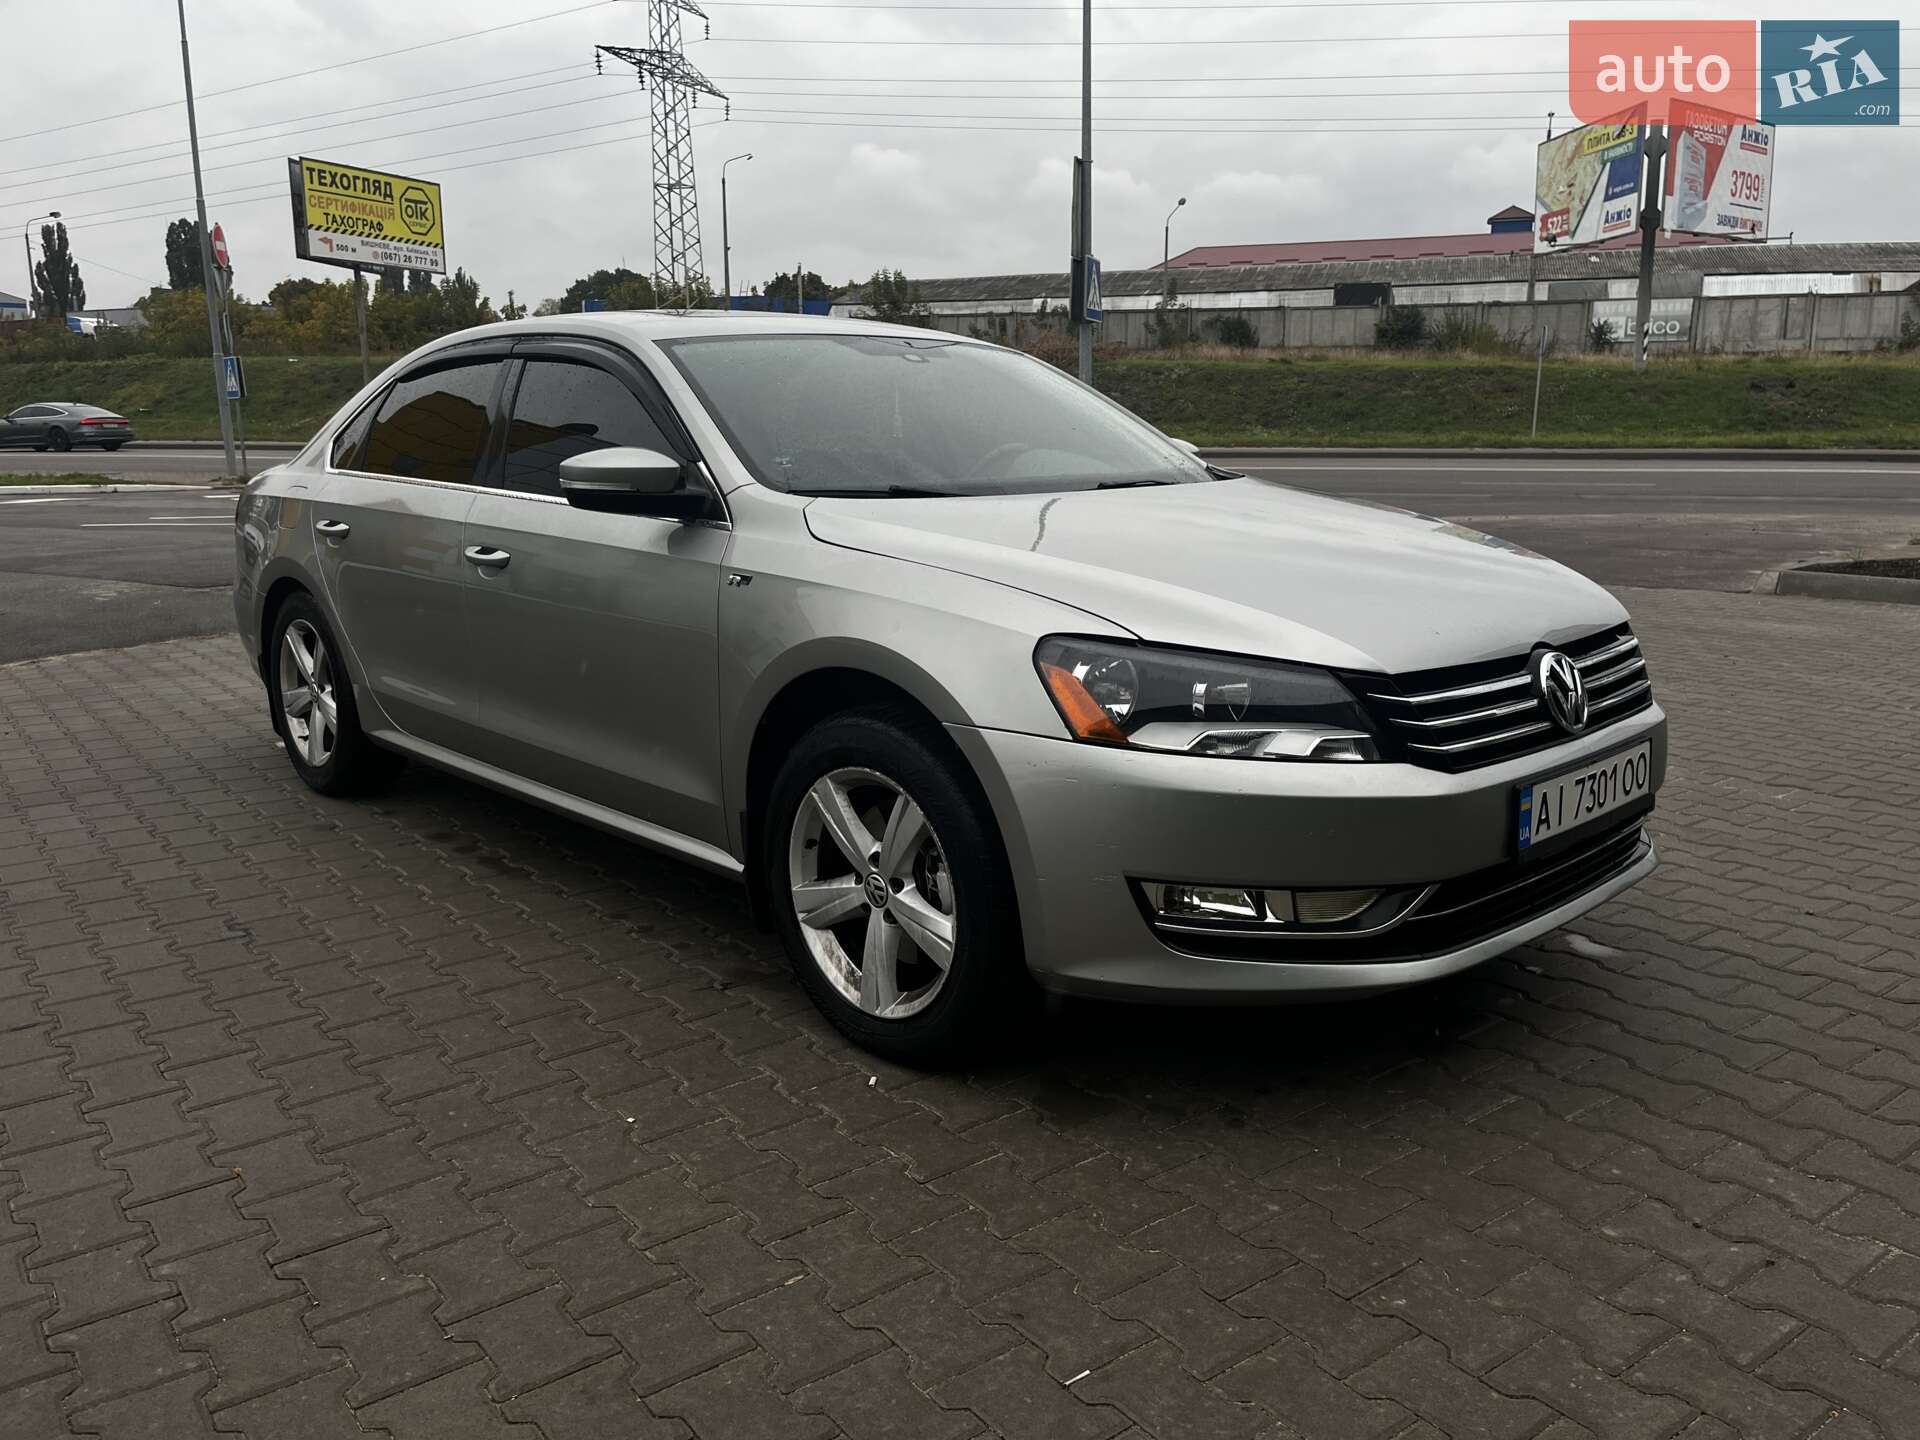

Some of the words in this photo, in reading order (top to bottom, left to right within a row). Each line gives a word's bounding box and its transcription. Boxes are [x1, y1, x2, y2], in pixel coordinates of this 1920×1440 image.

[306, 166, 394, 201] ТЕХОГЛЯД
[1730, 169, 1760, 201] 3799
[308, 194, 396, 221] СЕРТИФІКАЦІЯ
[323, 212, 384, 233] ТАХОГРАФ
[336, 244, 349, 252] 500
[1627, 317, 1680, 335] bico
[1534, 784, 1564, 836] AI
[1574, 763, 1618, 820] 7301
[1519, 827, 1530, 841] UA
